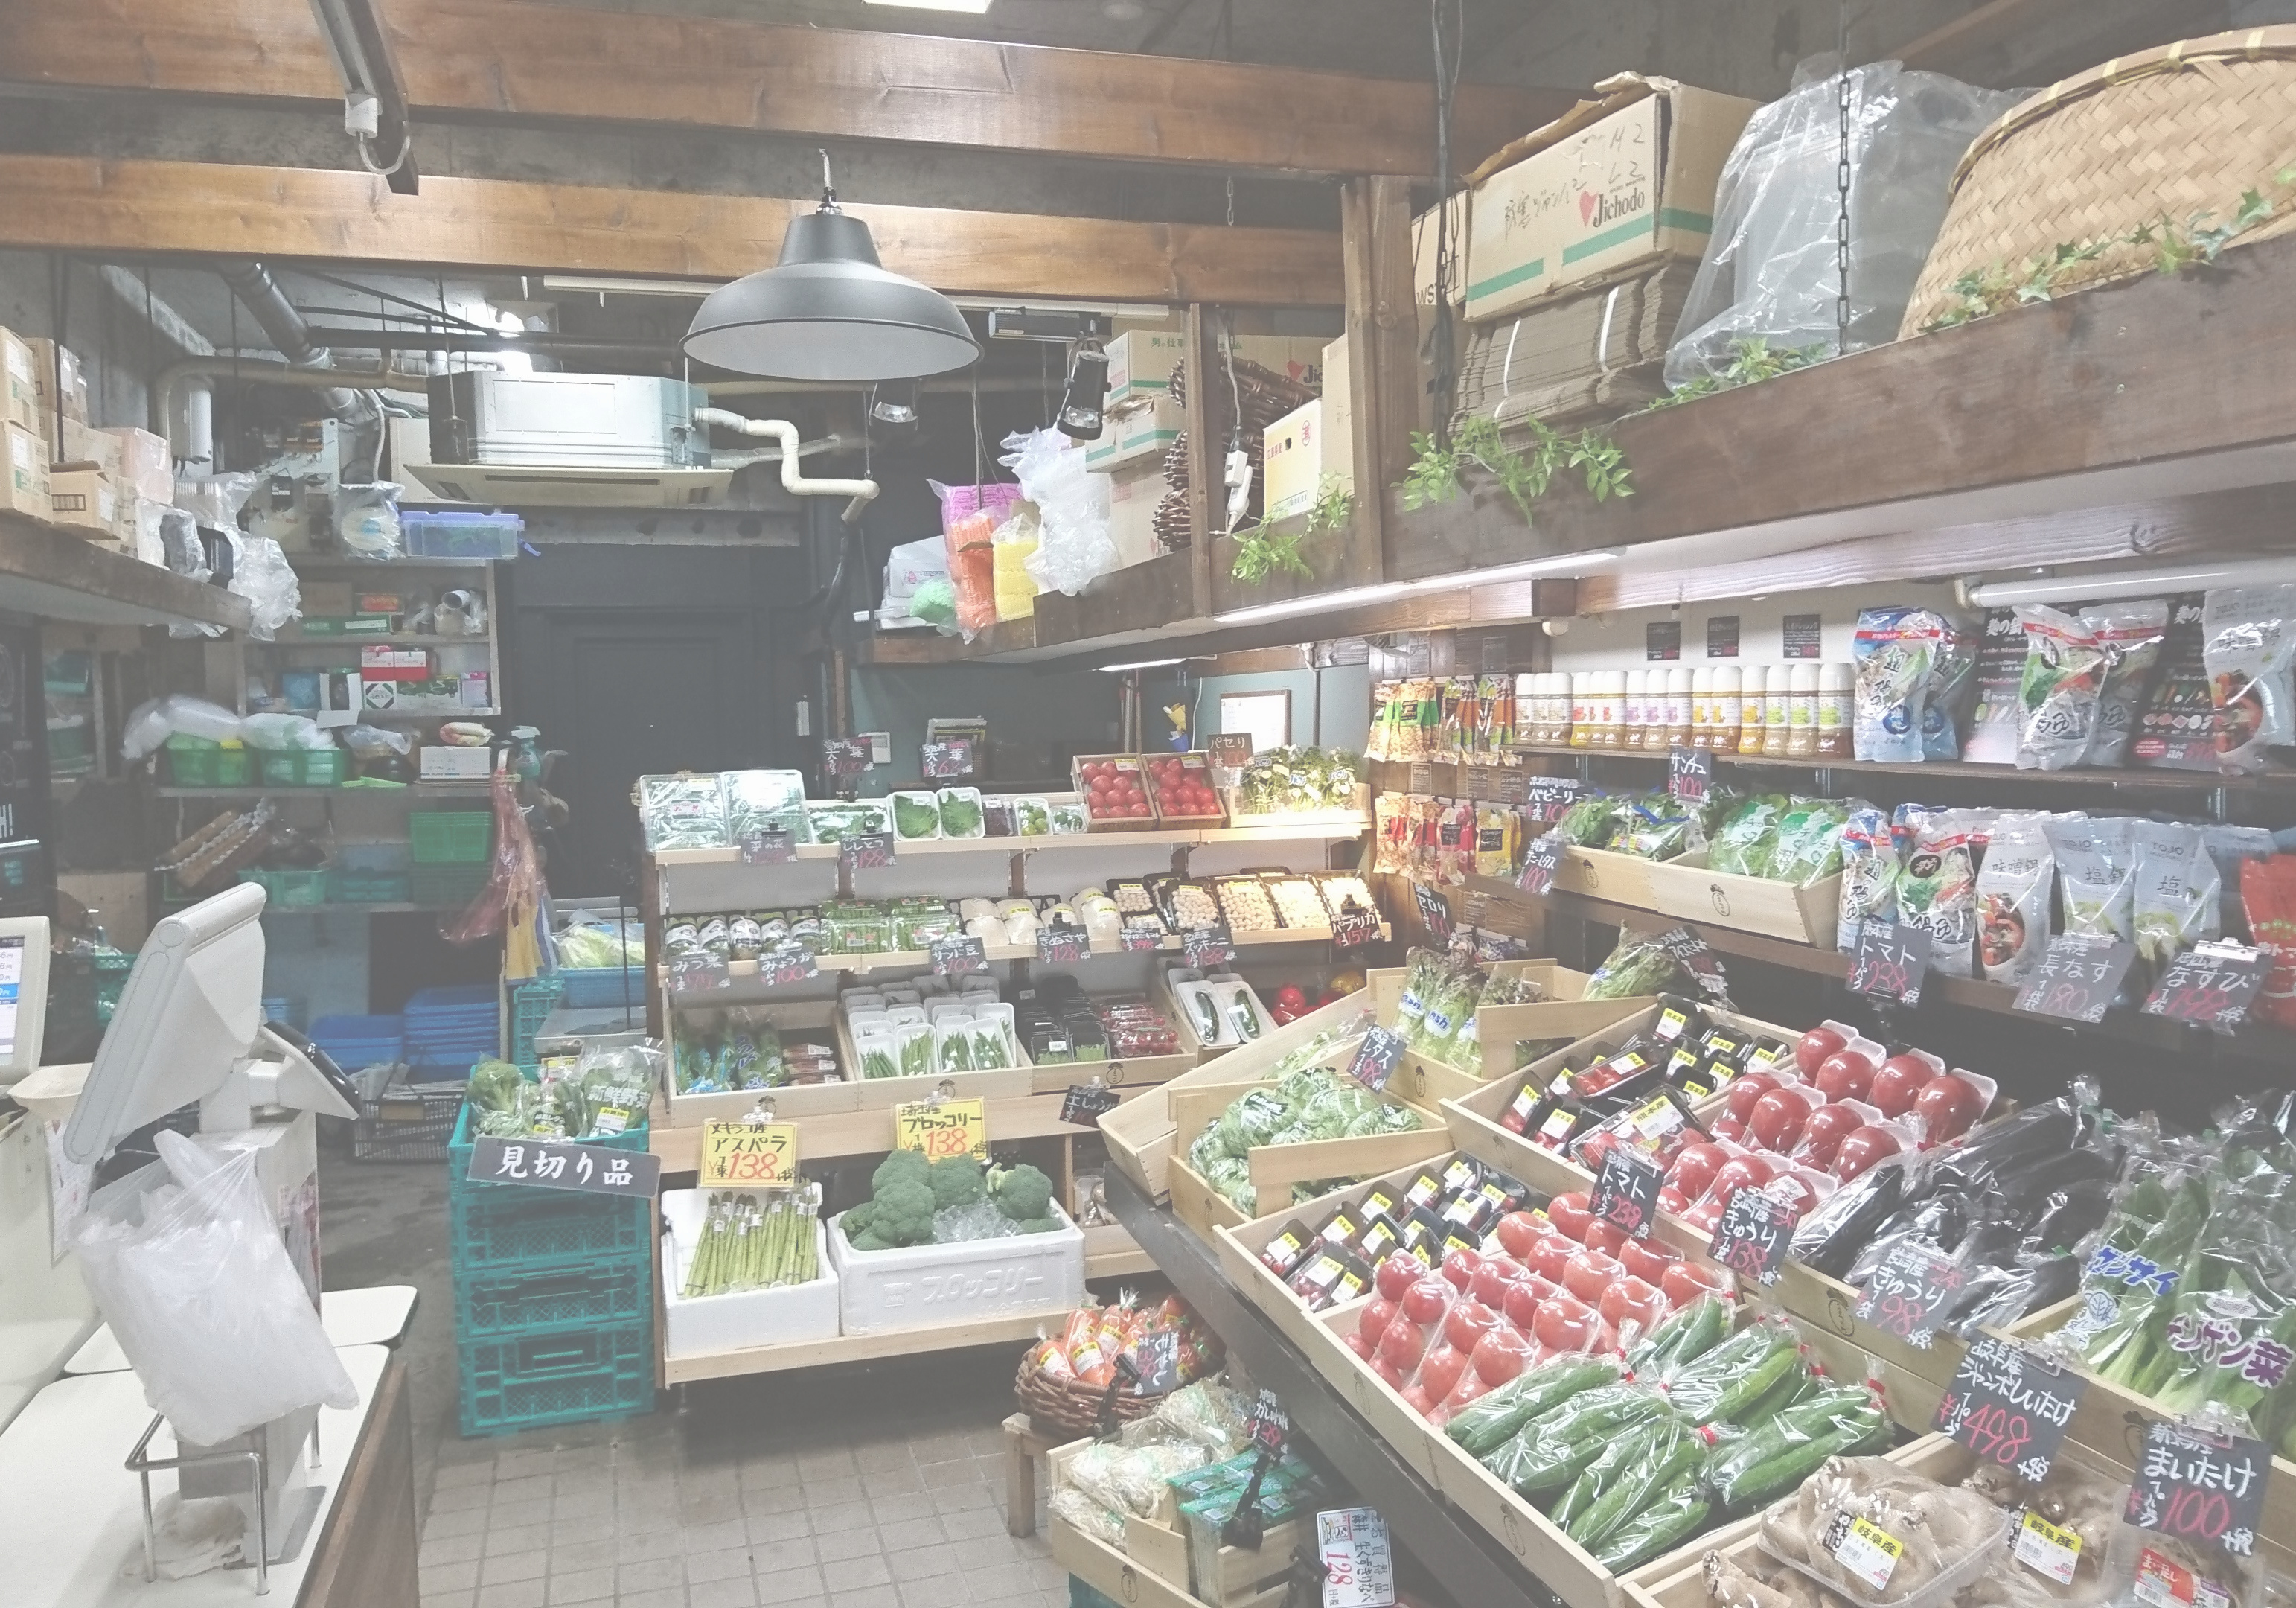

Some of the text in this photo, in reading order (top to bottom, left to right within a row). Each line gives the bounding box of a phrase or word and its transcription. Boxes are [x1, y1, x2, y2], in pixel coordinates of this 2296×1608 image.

[1592, 186, 1646, 229] Jichodo
[1209, 736, 1246, 750] パセリ
[1332, 911, 1376, 934] パプリカ
[1038, 932, 1088, 947] きぬさや
[1183, 936, 1229, 954] ズッキーニ
[1860, 937, 1917, 966] トマト
[761, 951, 816, 972] みょうが
[2037, 954, 2114, 984] 長なす
[2166, 966, 2260, 992] なすび
[1362, 1038, 1392, 1070] レタス
[901, 1115, 983, 1133] ブロッコリー
[713, 1134, 788, 1155] アスパラ
[494, 1145, 634, 1187] 見切り品
[1601, 1161, 1647, 1200] トマト
[1721, 1209, 1778, 1253] きゅうり
[921, 1266, 1045, 1305] ブロッコリー
[1872, 1265, 1948, 1312] きゅうり
[1969, 1339, 2027, 1376] 岐阜産
[1955, 1354, 2078, 1428] ジャンボしいたけ
[2143, 1446, 2258, 1499] まいたけ
[1857, 1525, 1897, 1557] 岐阜産
[2030, 1519, 2076, 1551] 岐阜産
[1325, 1551, 1353, 1586] 128
